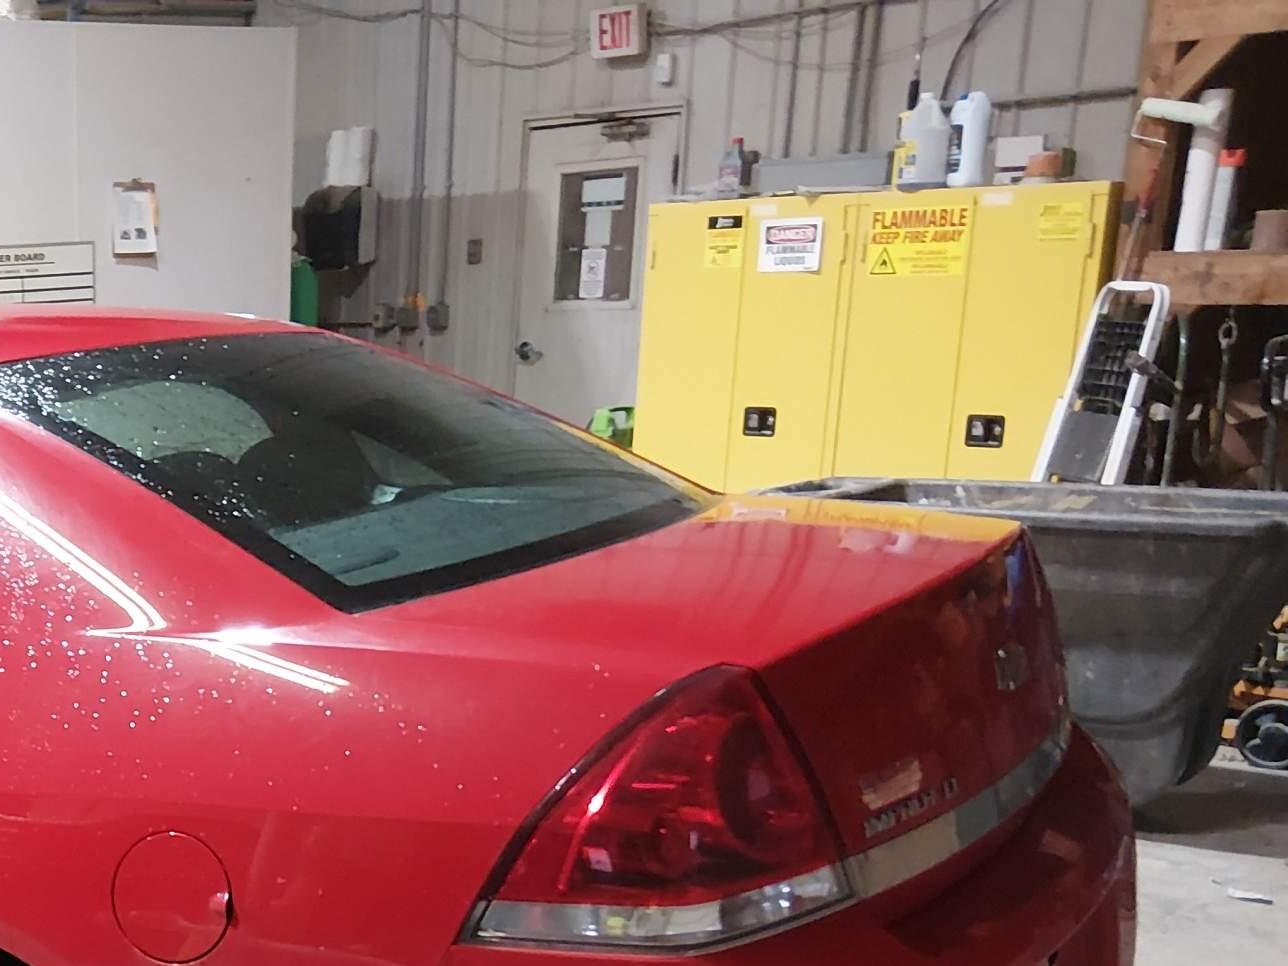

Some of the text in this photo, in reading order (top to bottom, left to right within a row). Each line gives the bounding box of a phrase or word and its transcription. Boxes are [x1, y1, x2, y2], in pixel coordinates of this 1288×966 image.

[598, 10, 632, 51] EXIT
[872, 207, 968, 229] FLAMMABLE
[872, 230, 965, 244] KEEP FIRE AWAY
[14, 253, 45, 262] BOARD
